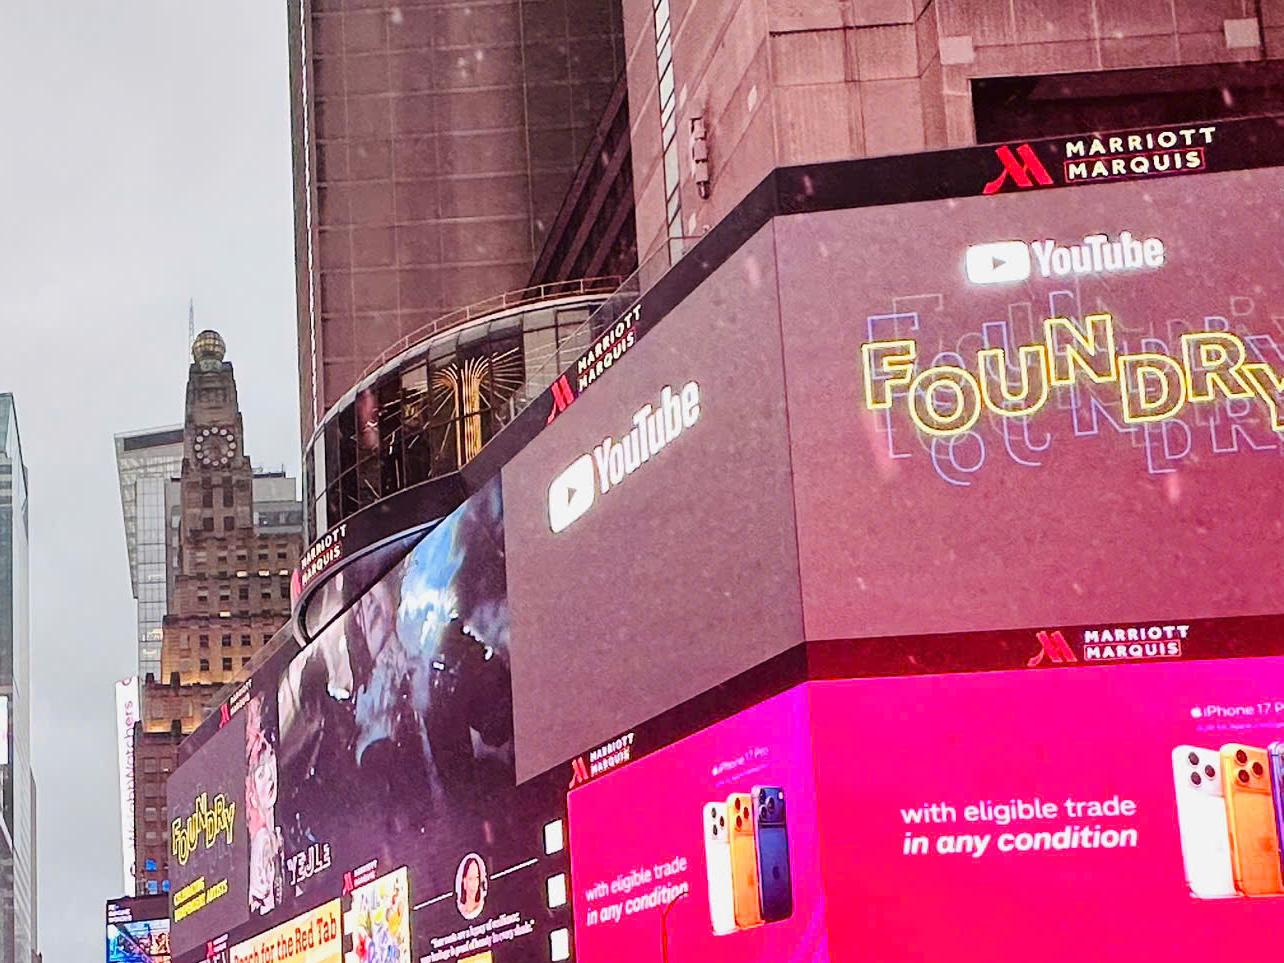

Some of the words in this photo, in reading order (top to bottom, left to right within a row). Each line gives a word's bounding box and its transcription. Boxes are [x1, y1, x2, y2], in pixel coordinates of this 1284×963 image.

[1065, 126, 1217, 159] MARRIOTT
[1067, 149, 1203, 179] MARQUIS
[1031, 230, 1165, 278] YouTube
[578, 304, 641, 374] MARRIOTT
[579, 332, 634, 392] MARQUIS
[594, 380, 701, 495] YouTube
[1084, 624, 1190, 644] MARRIOTT
[1086, 641, 1181, 658] MARQUIS
[1257, 702, 1271, 715] 17
[590, 733, 634, 763] MARRIOTT
[171, 792, 236, 865] FOUNDRY
[901, 801, 957, 826] with
[964, 797, 1060, 828] eligible
[1065, 795, 1137, 818] trade
[903, 831, 929, 855] in
[935, 832, 989, 860] any
[997, 824, 1138, 851] condition
[586, 882, 609, 901] with
[611, 869, 652, 894] eligible
[654, 855, 687, 879] trade
[587, 909, 598, 926] in
[600, 901, 623, 923] any
[625, 882, 689, 916] condition
[277, 935, 294, 961] the
[294, 920, 314, 954] Red
[316, 912, 337, 946] Tab
